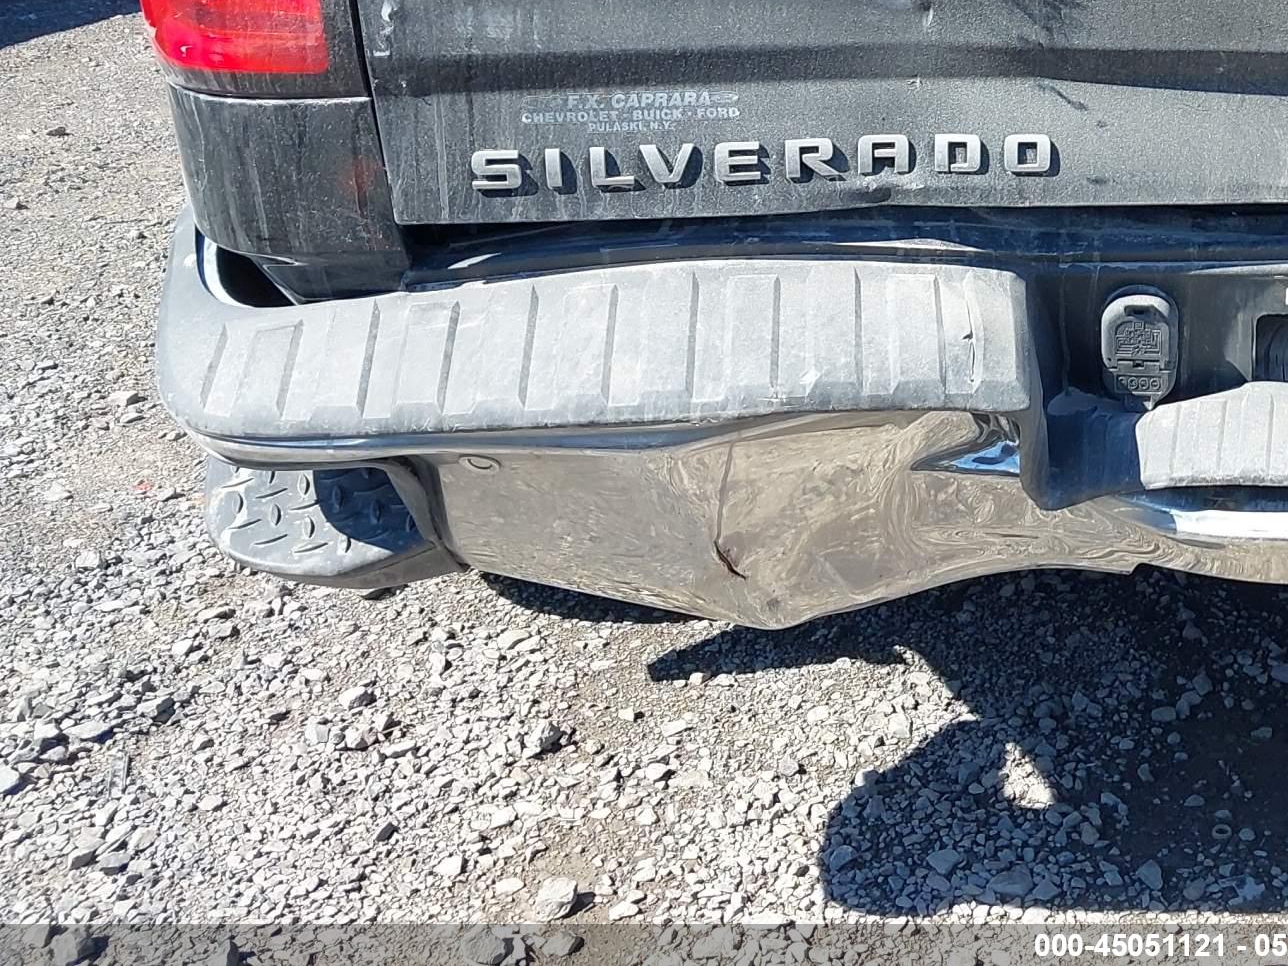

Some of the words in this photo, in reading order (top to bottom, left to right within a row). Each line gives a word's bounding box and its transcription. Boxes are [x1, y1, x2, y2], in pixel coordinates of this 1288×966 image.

[611, 91, 711, 110] CAPRARA
[521, 110, 619, 124] CHEVROLET
[632, 108, 682, 121] BUICK
[696, 106, 740, 119] FORD
[471, 133, 1052, 191] SILVERADO
